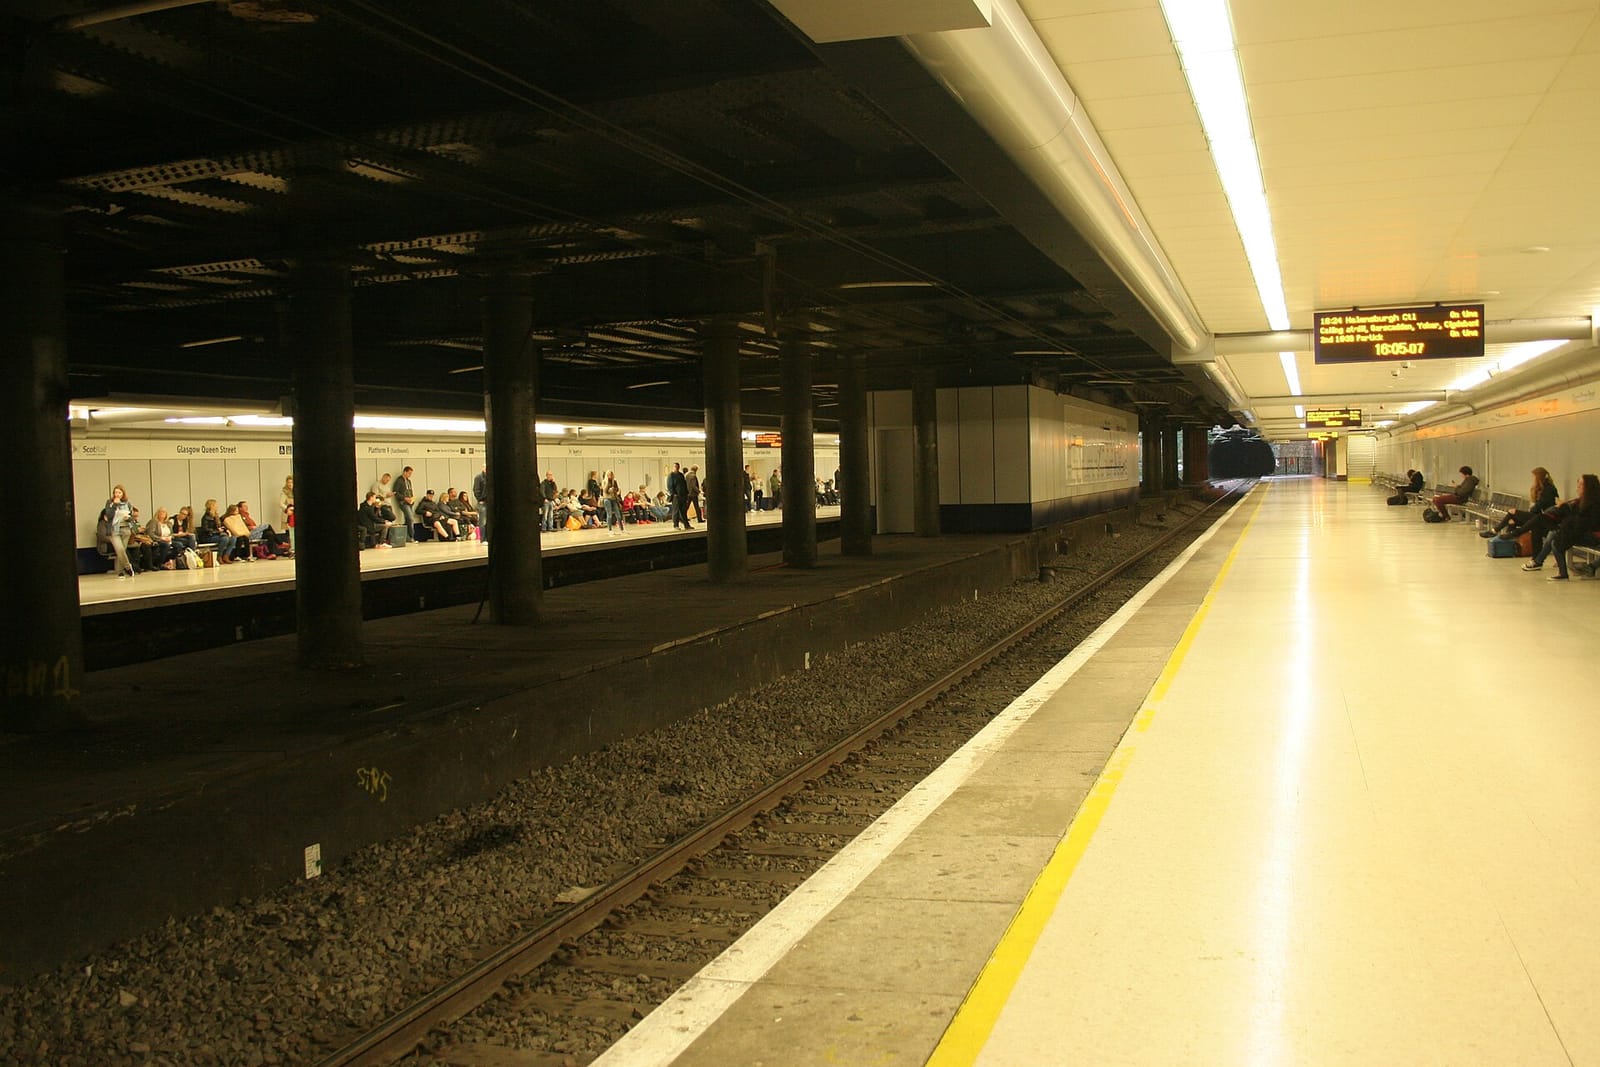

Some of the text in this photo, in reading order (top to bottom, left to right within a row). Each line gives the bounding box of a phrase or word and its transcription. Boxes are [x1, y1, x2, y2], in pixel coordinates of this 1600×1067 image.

[176, 445, 237, 455] Glasgow Queen Street
